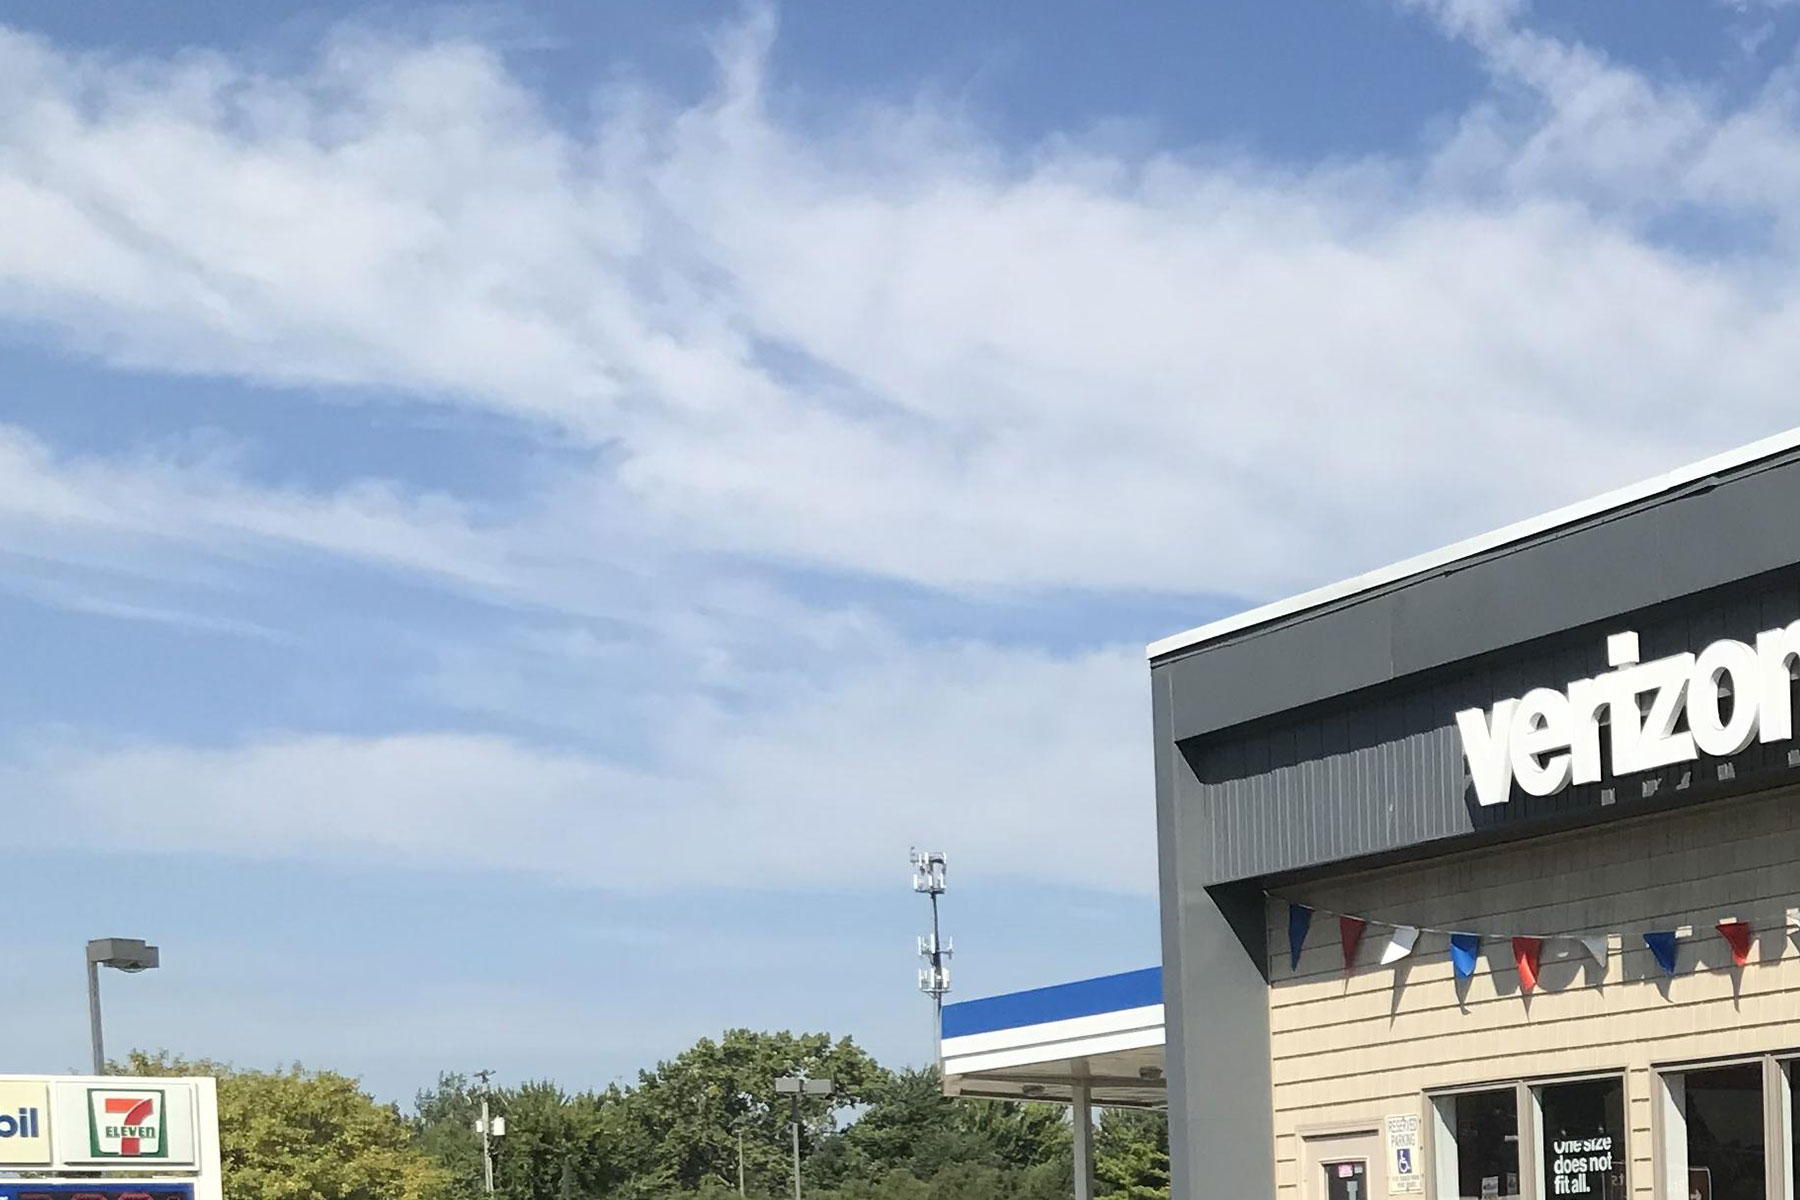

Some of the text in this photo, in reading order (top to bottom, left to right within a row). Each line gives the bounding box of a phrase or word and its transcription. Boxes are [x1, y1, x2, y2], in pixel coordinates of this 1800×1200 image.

[0, 1108, 39, 1138] oil
[105, 1098, 153, 1156] 7
[1388, 1117, 1418, 1133] RESERVED
[1391, 1133, 1416, 1147] PARKING
[1554, 1151, 1612, 1174] does not
[1554, 1175, 1571, 1195] fit
[1571, 1173, 1591, 1194] all.
